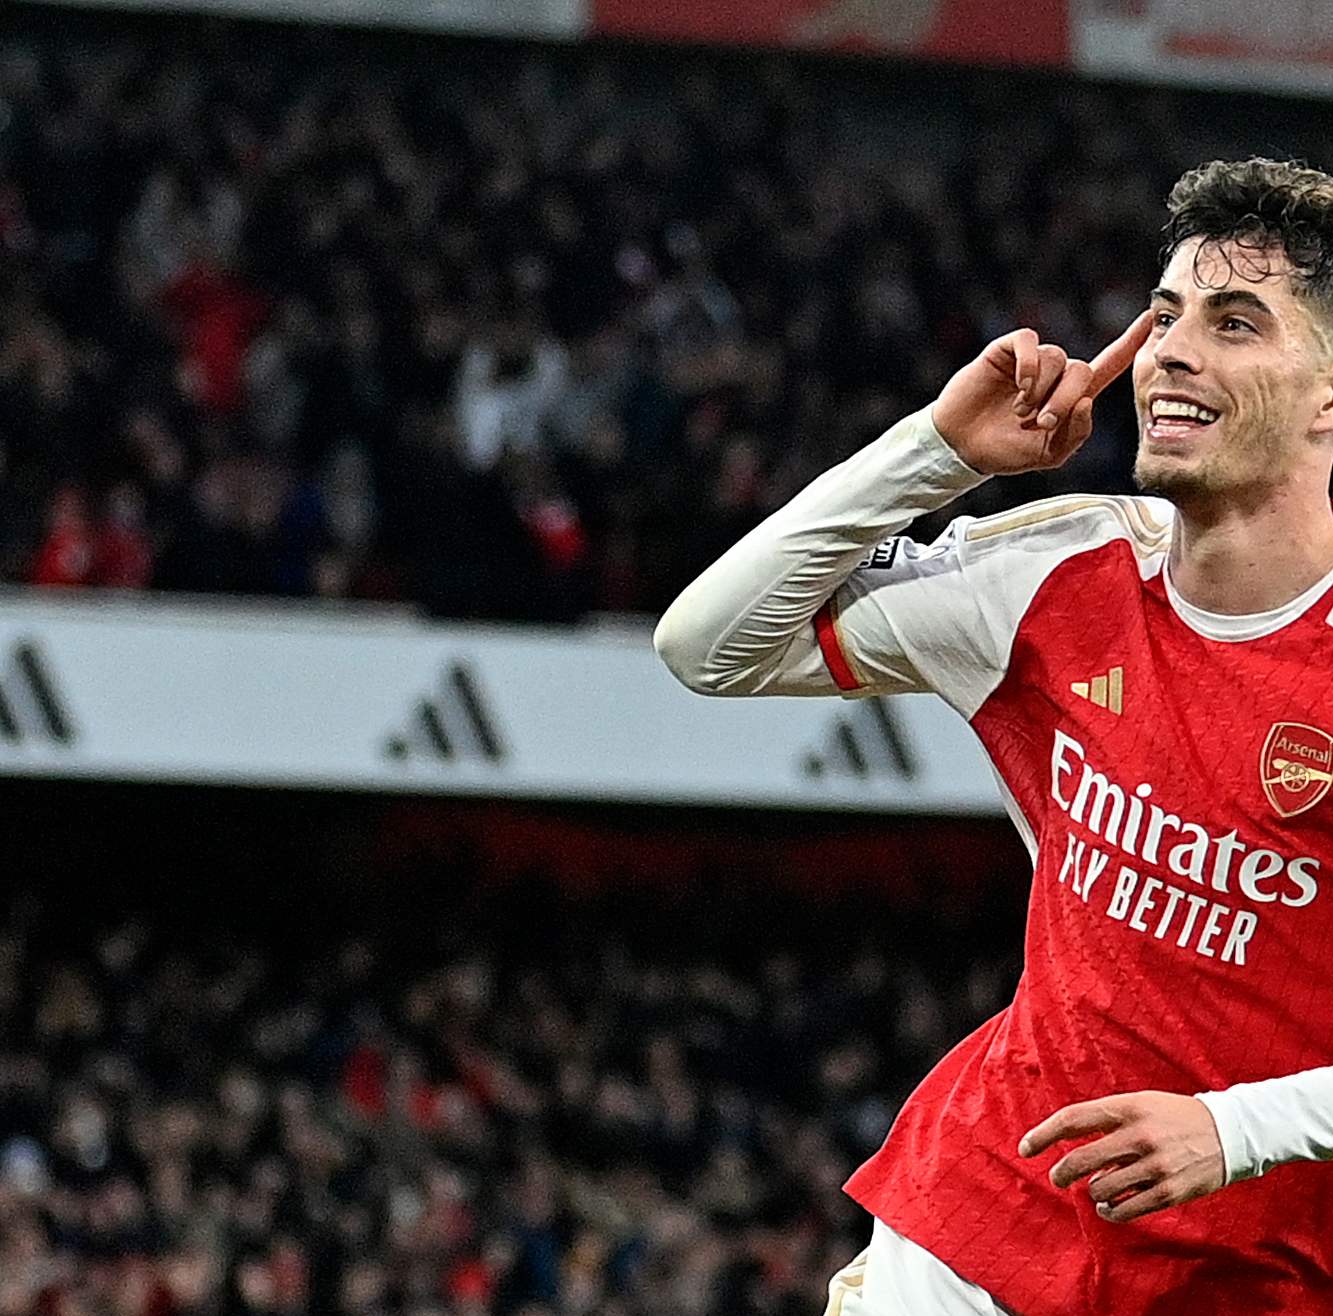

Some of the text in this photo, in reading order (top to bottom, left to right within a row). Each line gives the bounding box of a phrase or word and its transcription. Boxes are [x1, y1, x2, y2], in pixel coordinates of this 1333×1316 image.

[1051, 728, 1321, 907] Emirates
[1276, 737, 1328, 764] Arsenal
[1058, 832, 1258, 966] FLY BETTER
